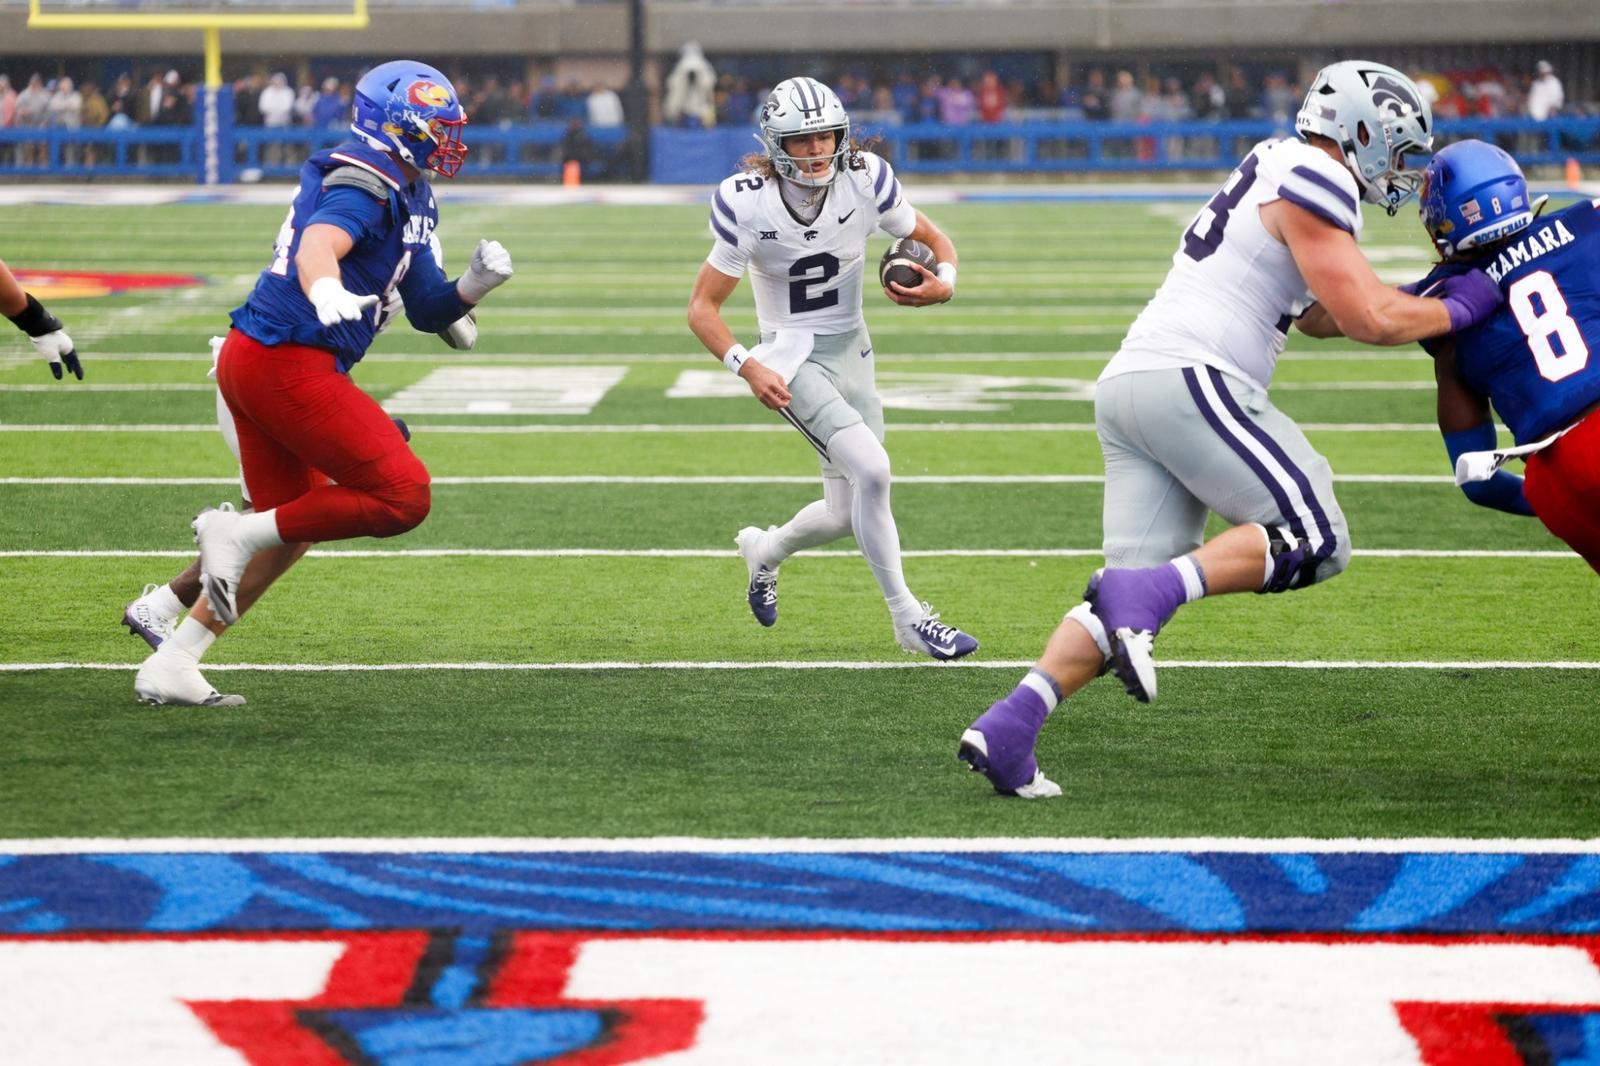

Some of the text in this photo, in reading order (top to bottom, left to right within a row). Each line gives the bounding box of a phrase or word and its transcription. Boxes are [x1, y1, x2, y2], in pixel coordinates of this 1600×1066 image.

[735, 176, 764, 193] 2
[1491, 196, 1502, 216] 8
[759, 230, 779, 240] XII
[1502, 216, 1529, 236] CHALK
[1485, 218, 1576, 285] KAMARA
[788, 251, 840, 315] 2
[1508, 268, 1591, 384] 8
